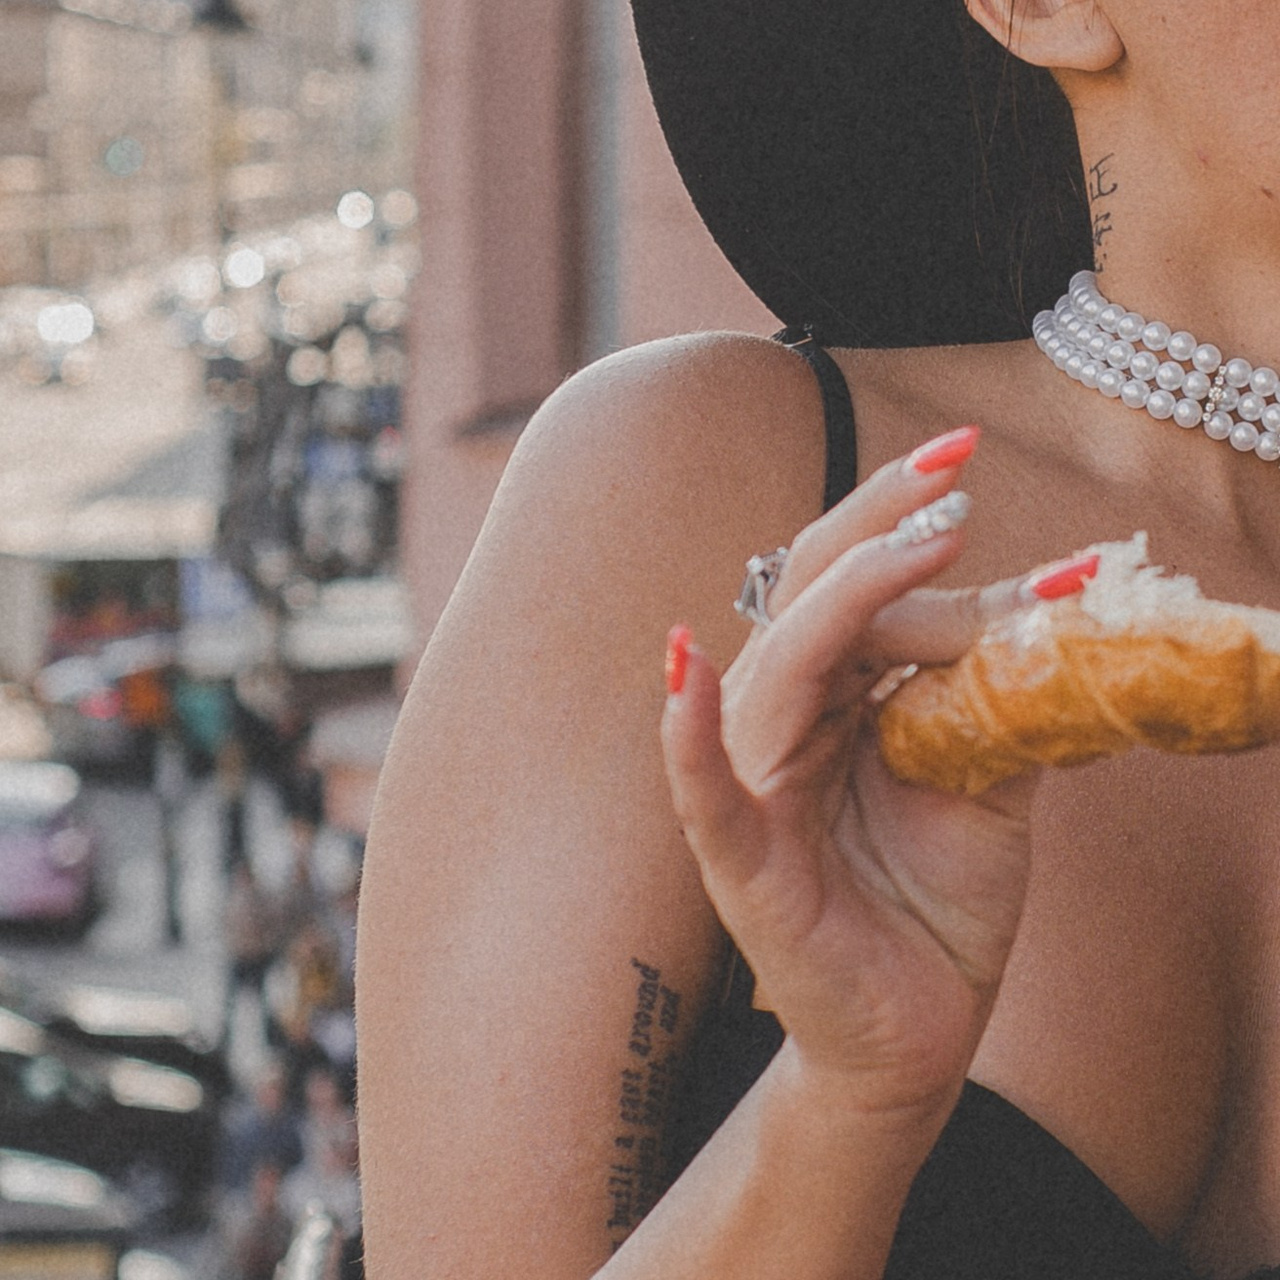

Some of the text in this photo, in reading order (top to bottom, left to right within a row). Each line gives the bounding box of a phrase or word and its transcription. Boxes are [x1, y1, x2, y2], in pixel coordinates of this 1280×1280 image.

[614, 1135, 635, 1149] a
[628, 956, 659, 1057] around
[659, 984, 681, 1034] and
